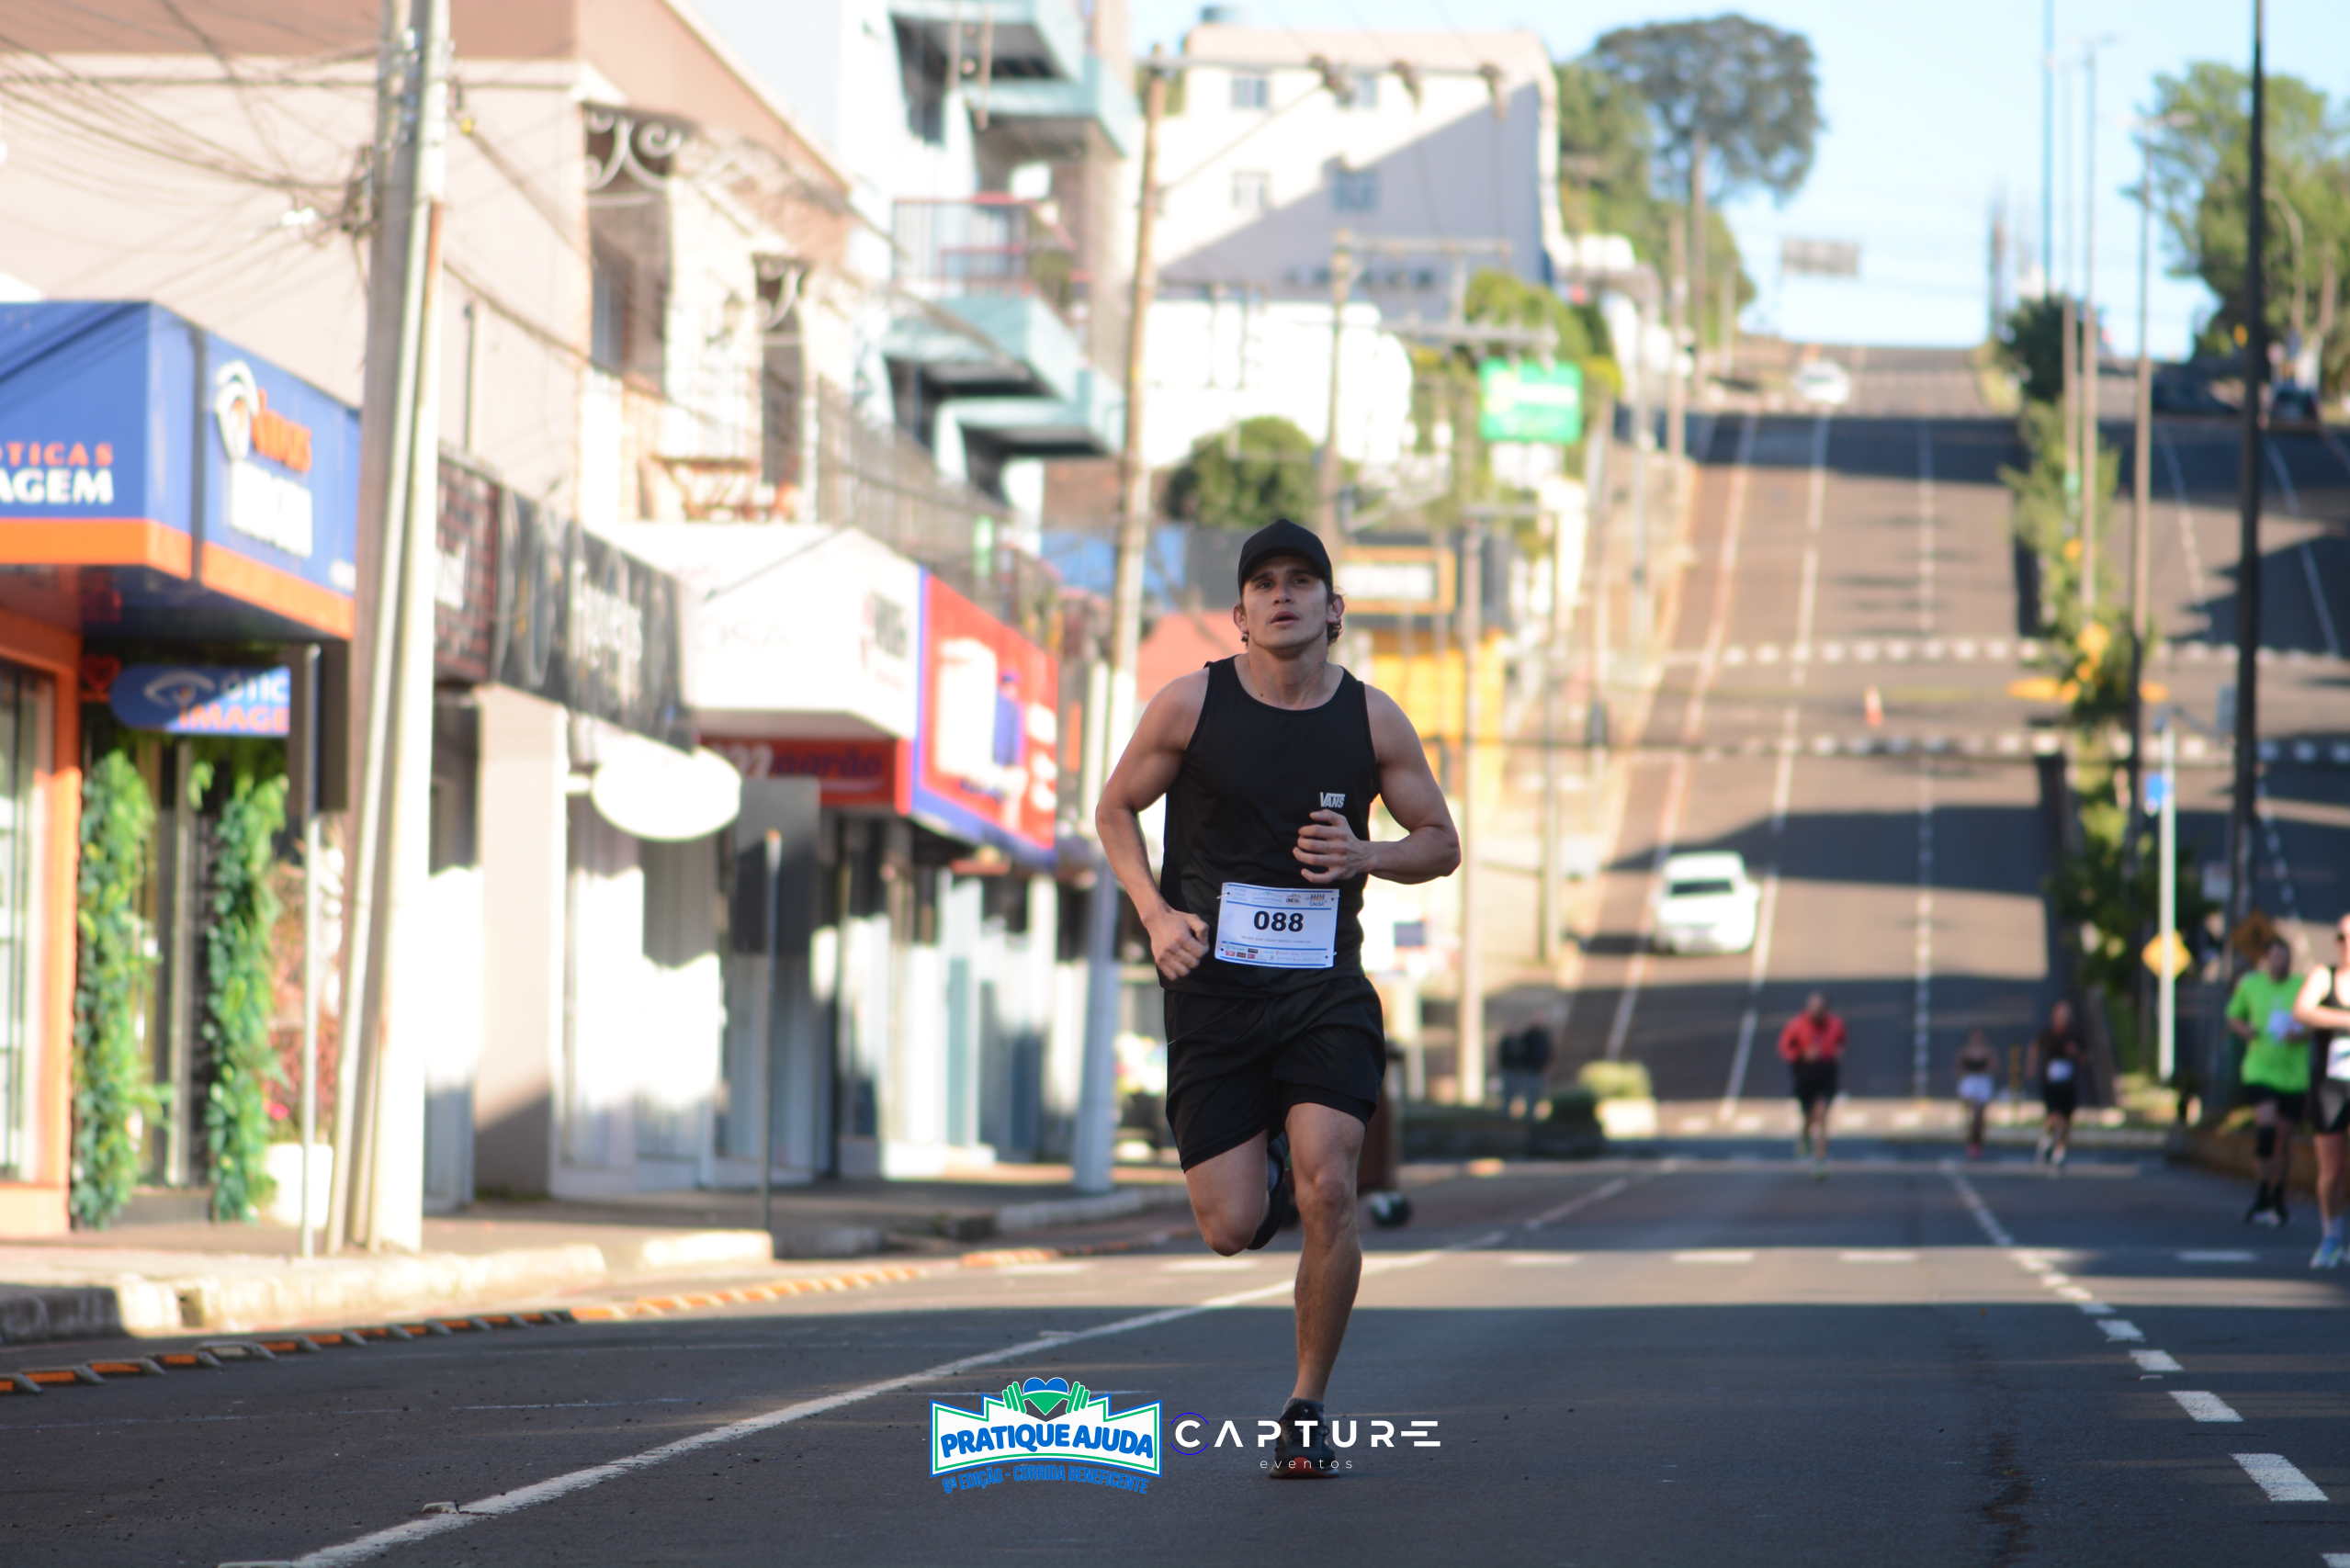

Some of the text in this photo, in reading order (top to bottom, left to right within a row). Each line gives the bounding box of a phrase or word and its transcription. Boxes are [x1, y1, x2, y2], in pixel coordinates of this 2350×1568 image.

[0, 441, 114, 467] TICAS
[1320, 792, 1346, 808] VANS
[1254, 910, 1304, 932] 088
